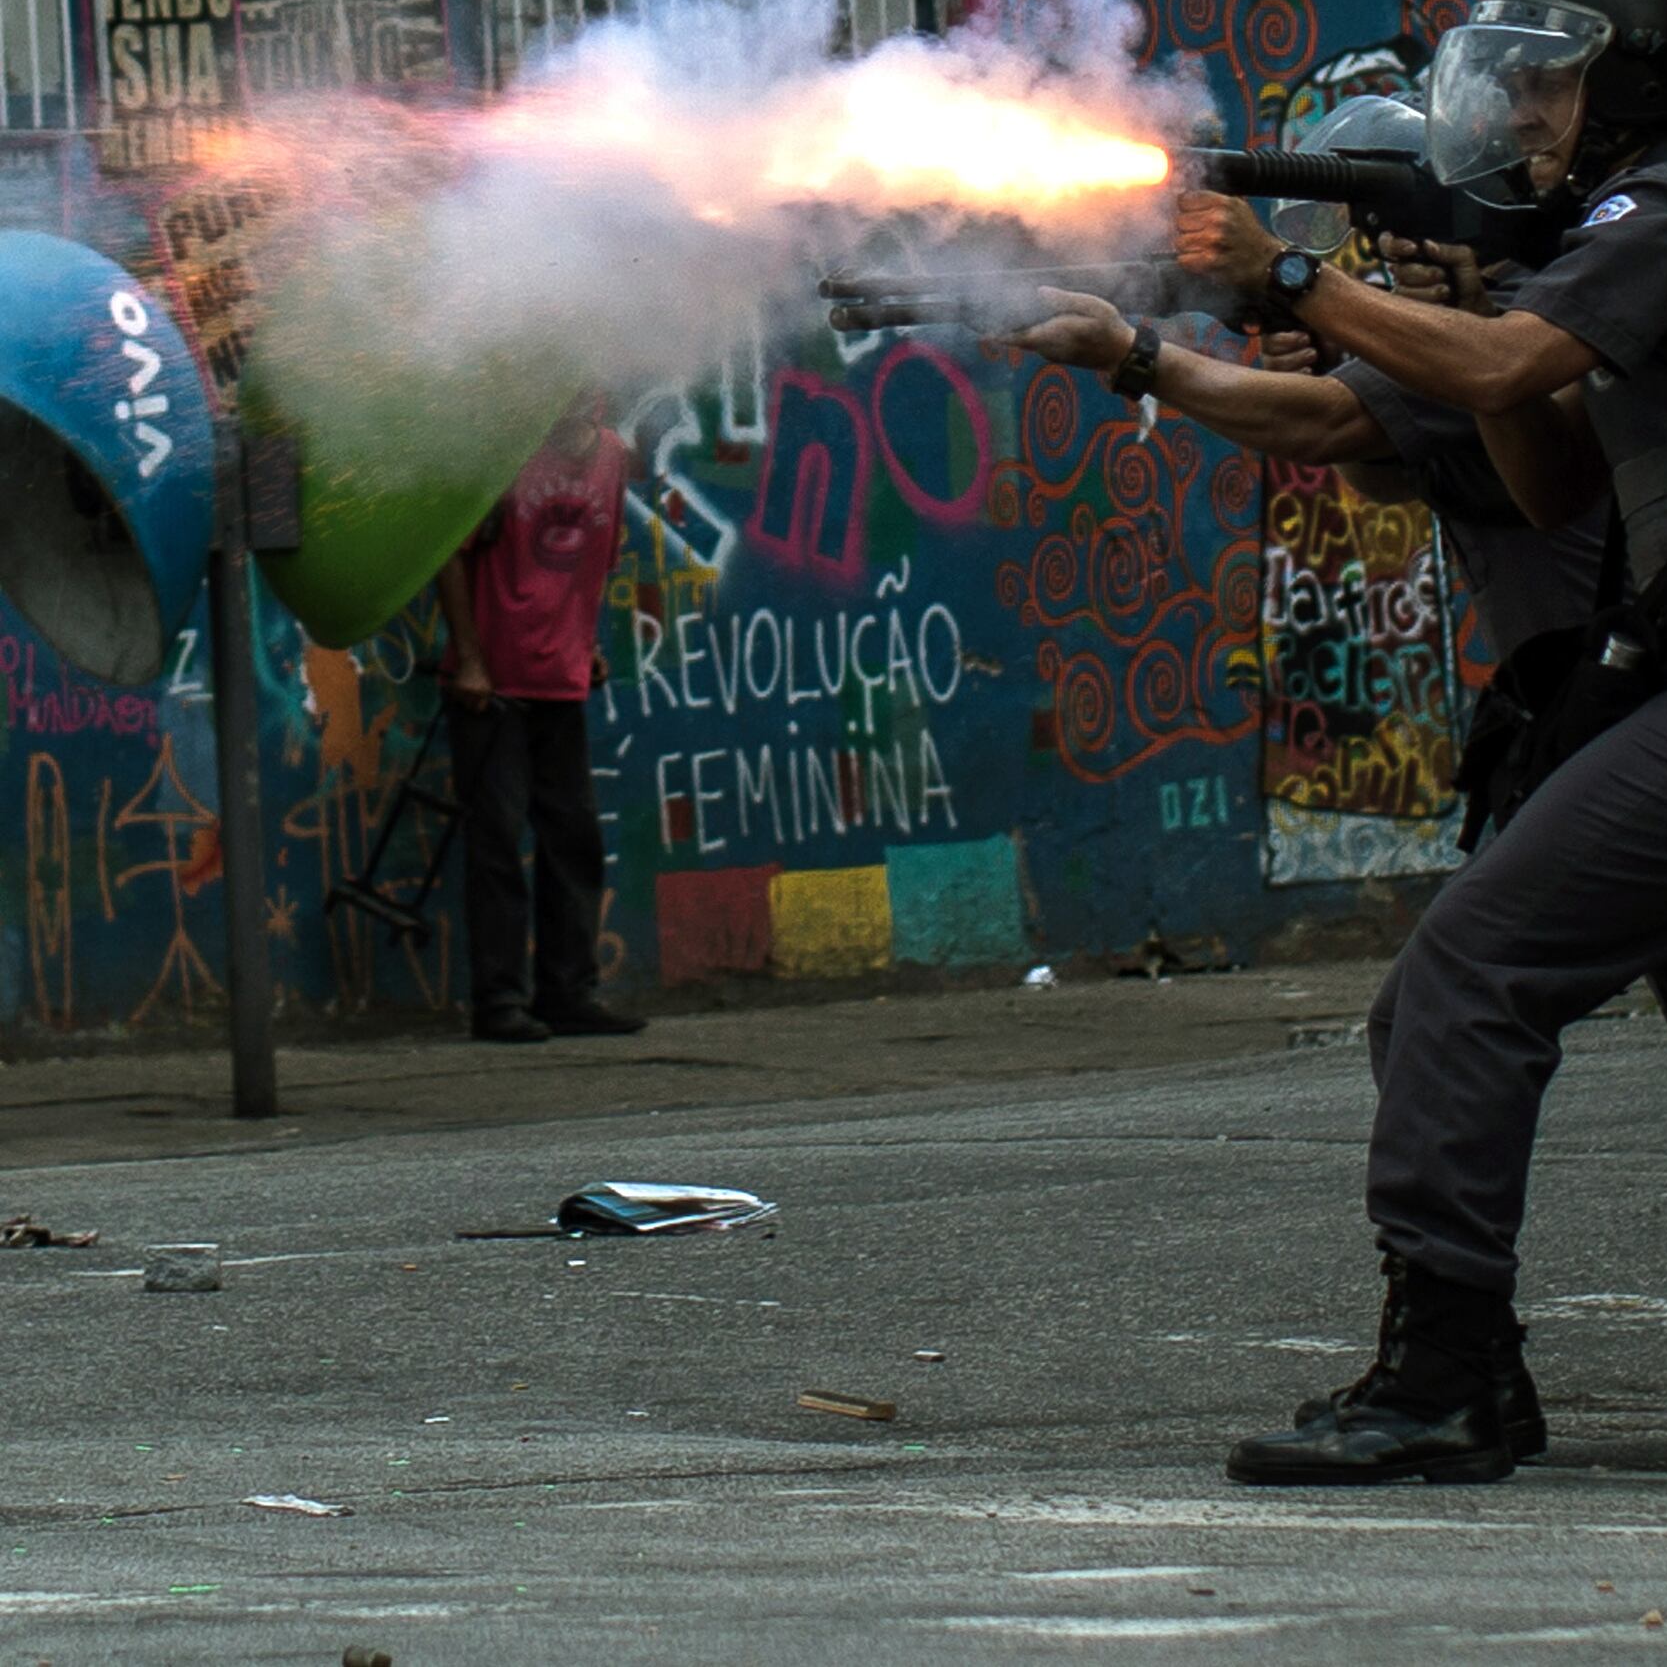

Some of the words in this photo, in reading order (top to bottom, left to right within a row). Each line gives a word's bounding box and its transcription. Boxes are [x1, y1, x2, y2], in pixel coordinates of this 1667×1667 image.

[111, 22, 223, 111] SUA
[110, 289, 173, 477] vivo
[633, 554, 962, 735] REVOLUÇÃO
